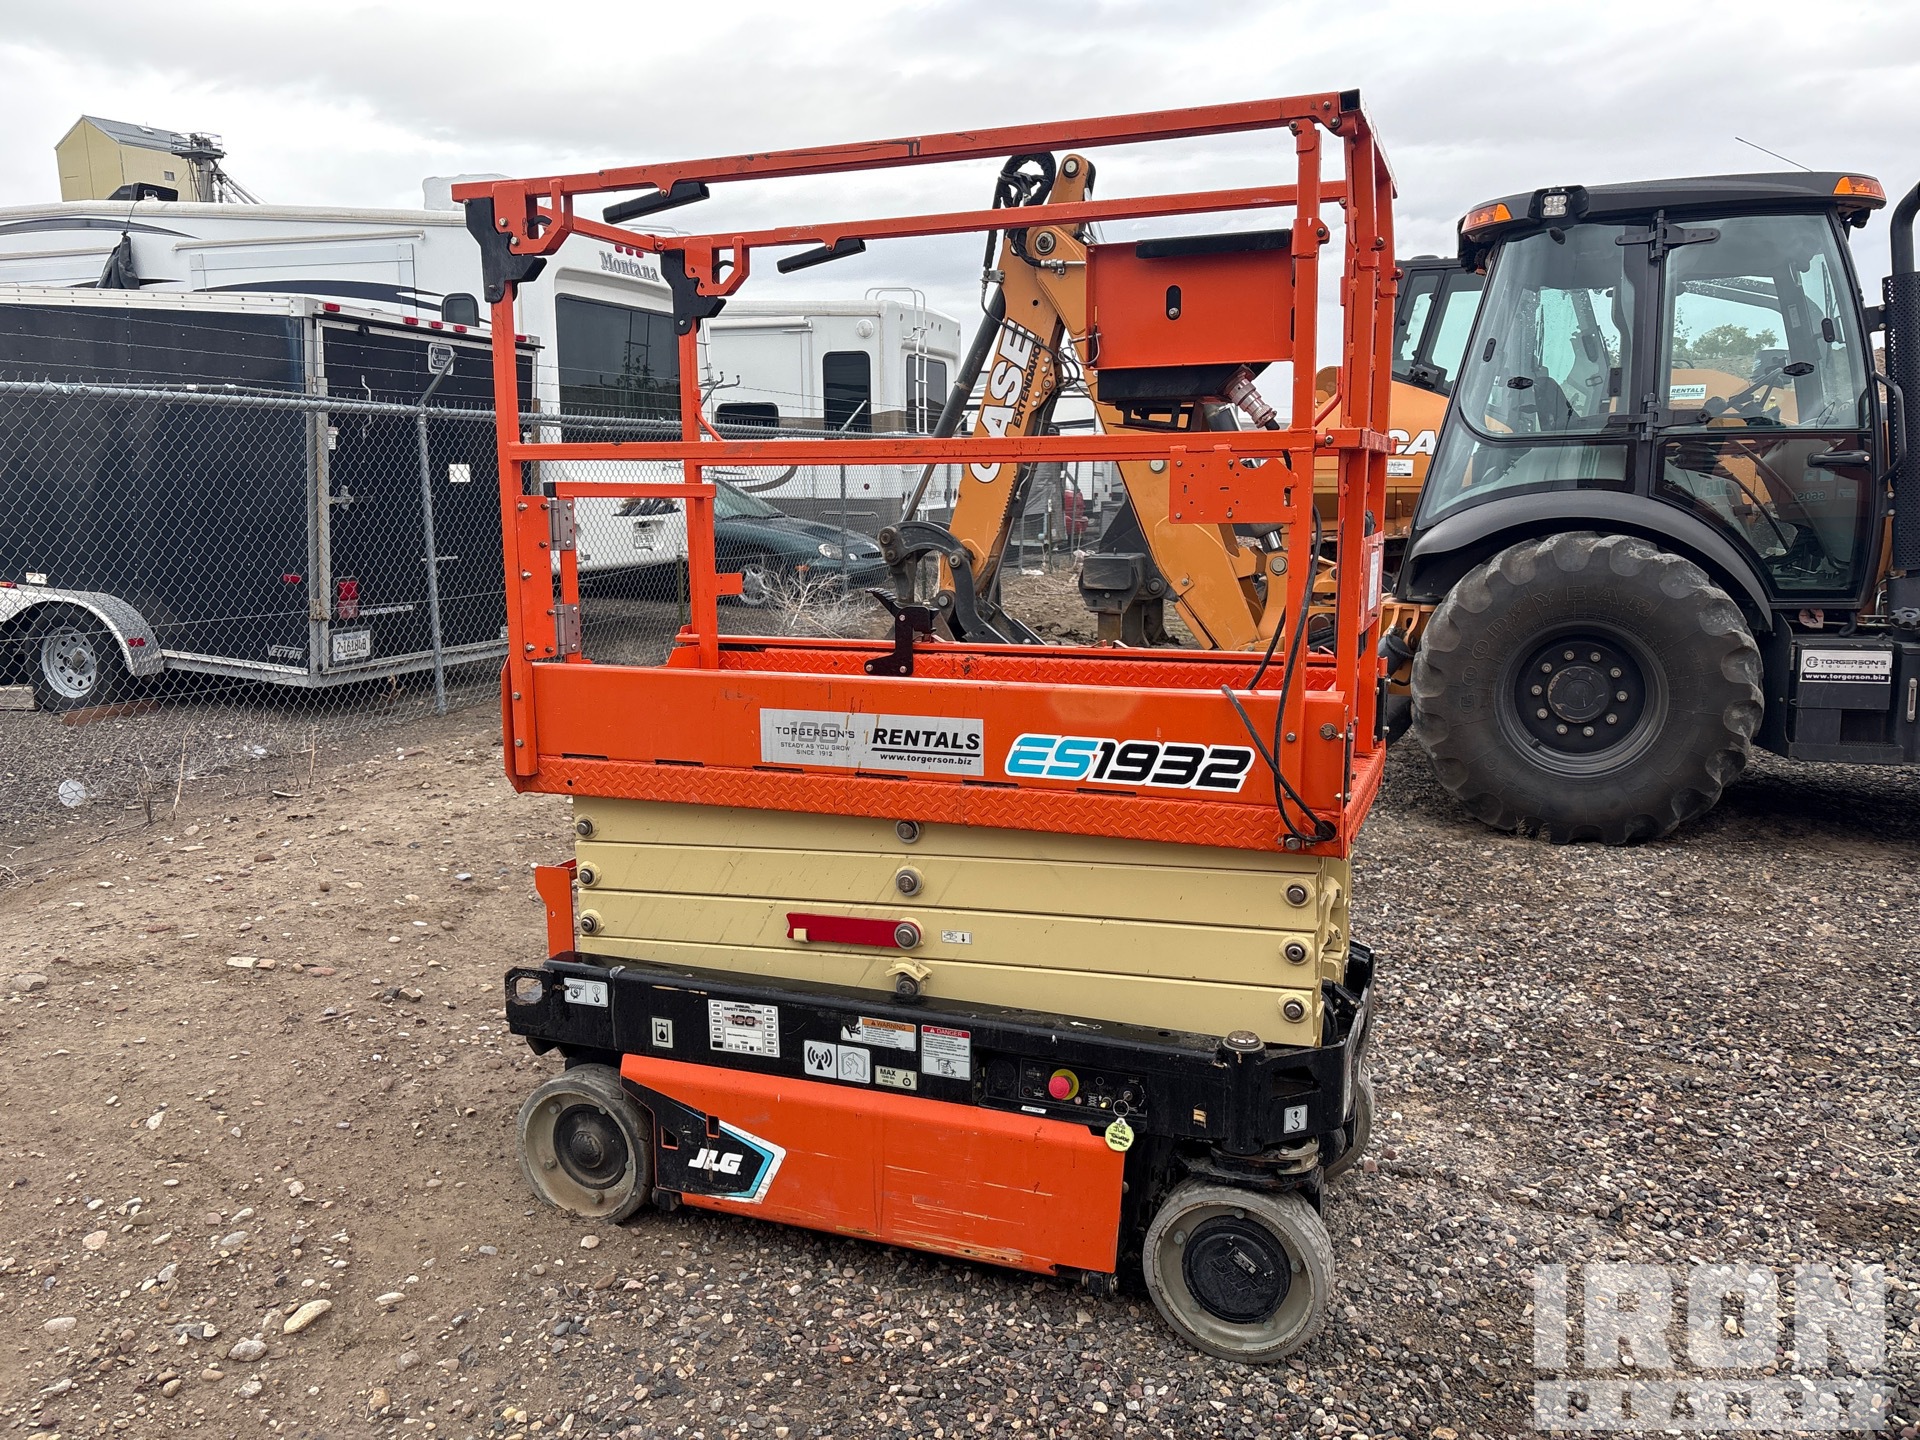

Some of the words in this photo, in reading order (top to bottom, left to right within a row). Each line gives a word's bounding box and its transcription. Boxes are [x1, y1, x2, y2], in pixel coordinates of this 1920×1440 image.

[599, 250, 660, 282] Montana
[775, 726, 855, 739] TORGERSON'S
[872, 727, 981, 750] RENTALS
[780, 741, 805, 749] STEADY
[880, 752, 972, 765] www.torgerson.biz
[1006, 735, 1253, 791] ES1932
[877, 1021, 906, 1031] WARNING
[936, 1028, 963, 1037] DANGER
[880, 1068, 896, 1077] MAX
[687, 1147, 743, 1175] JLG
